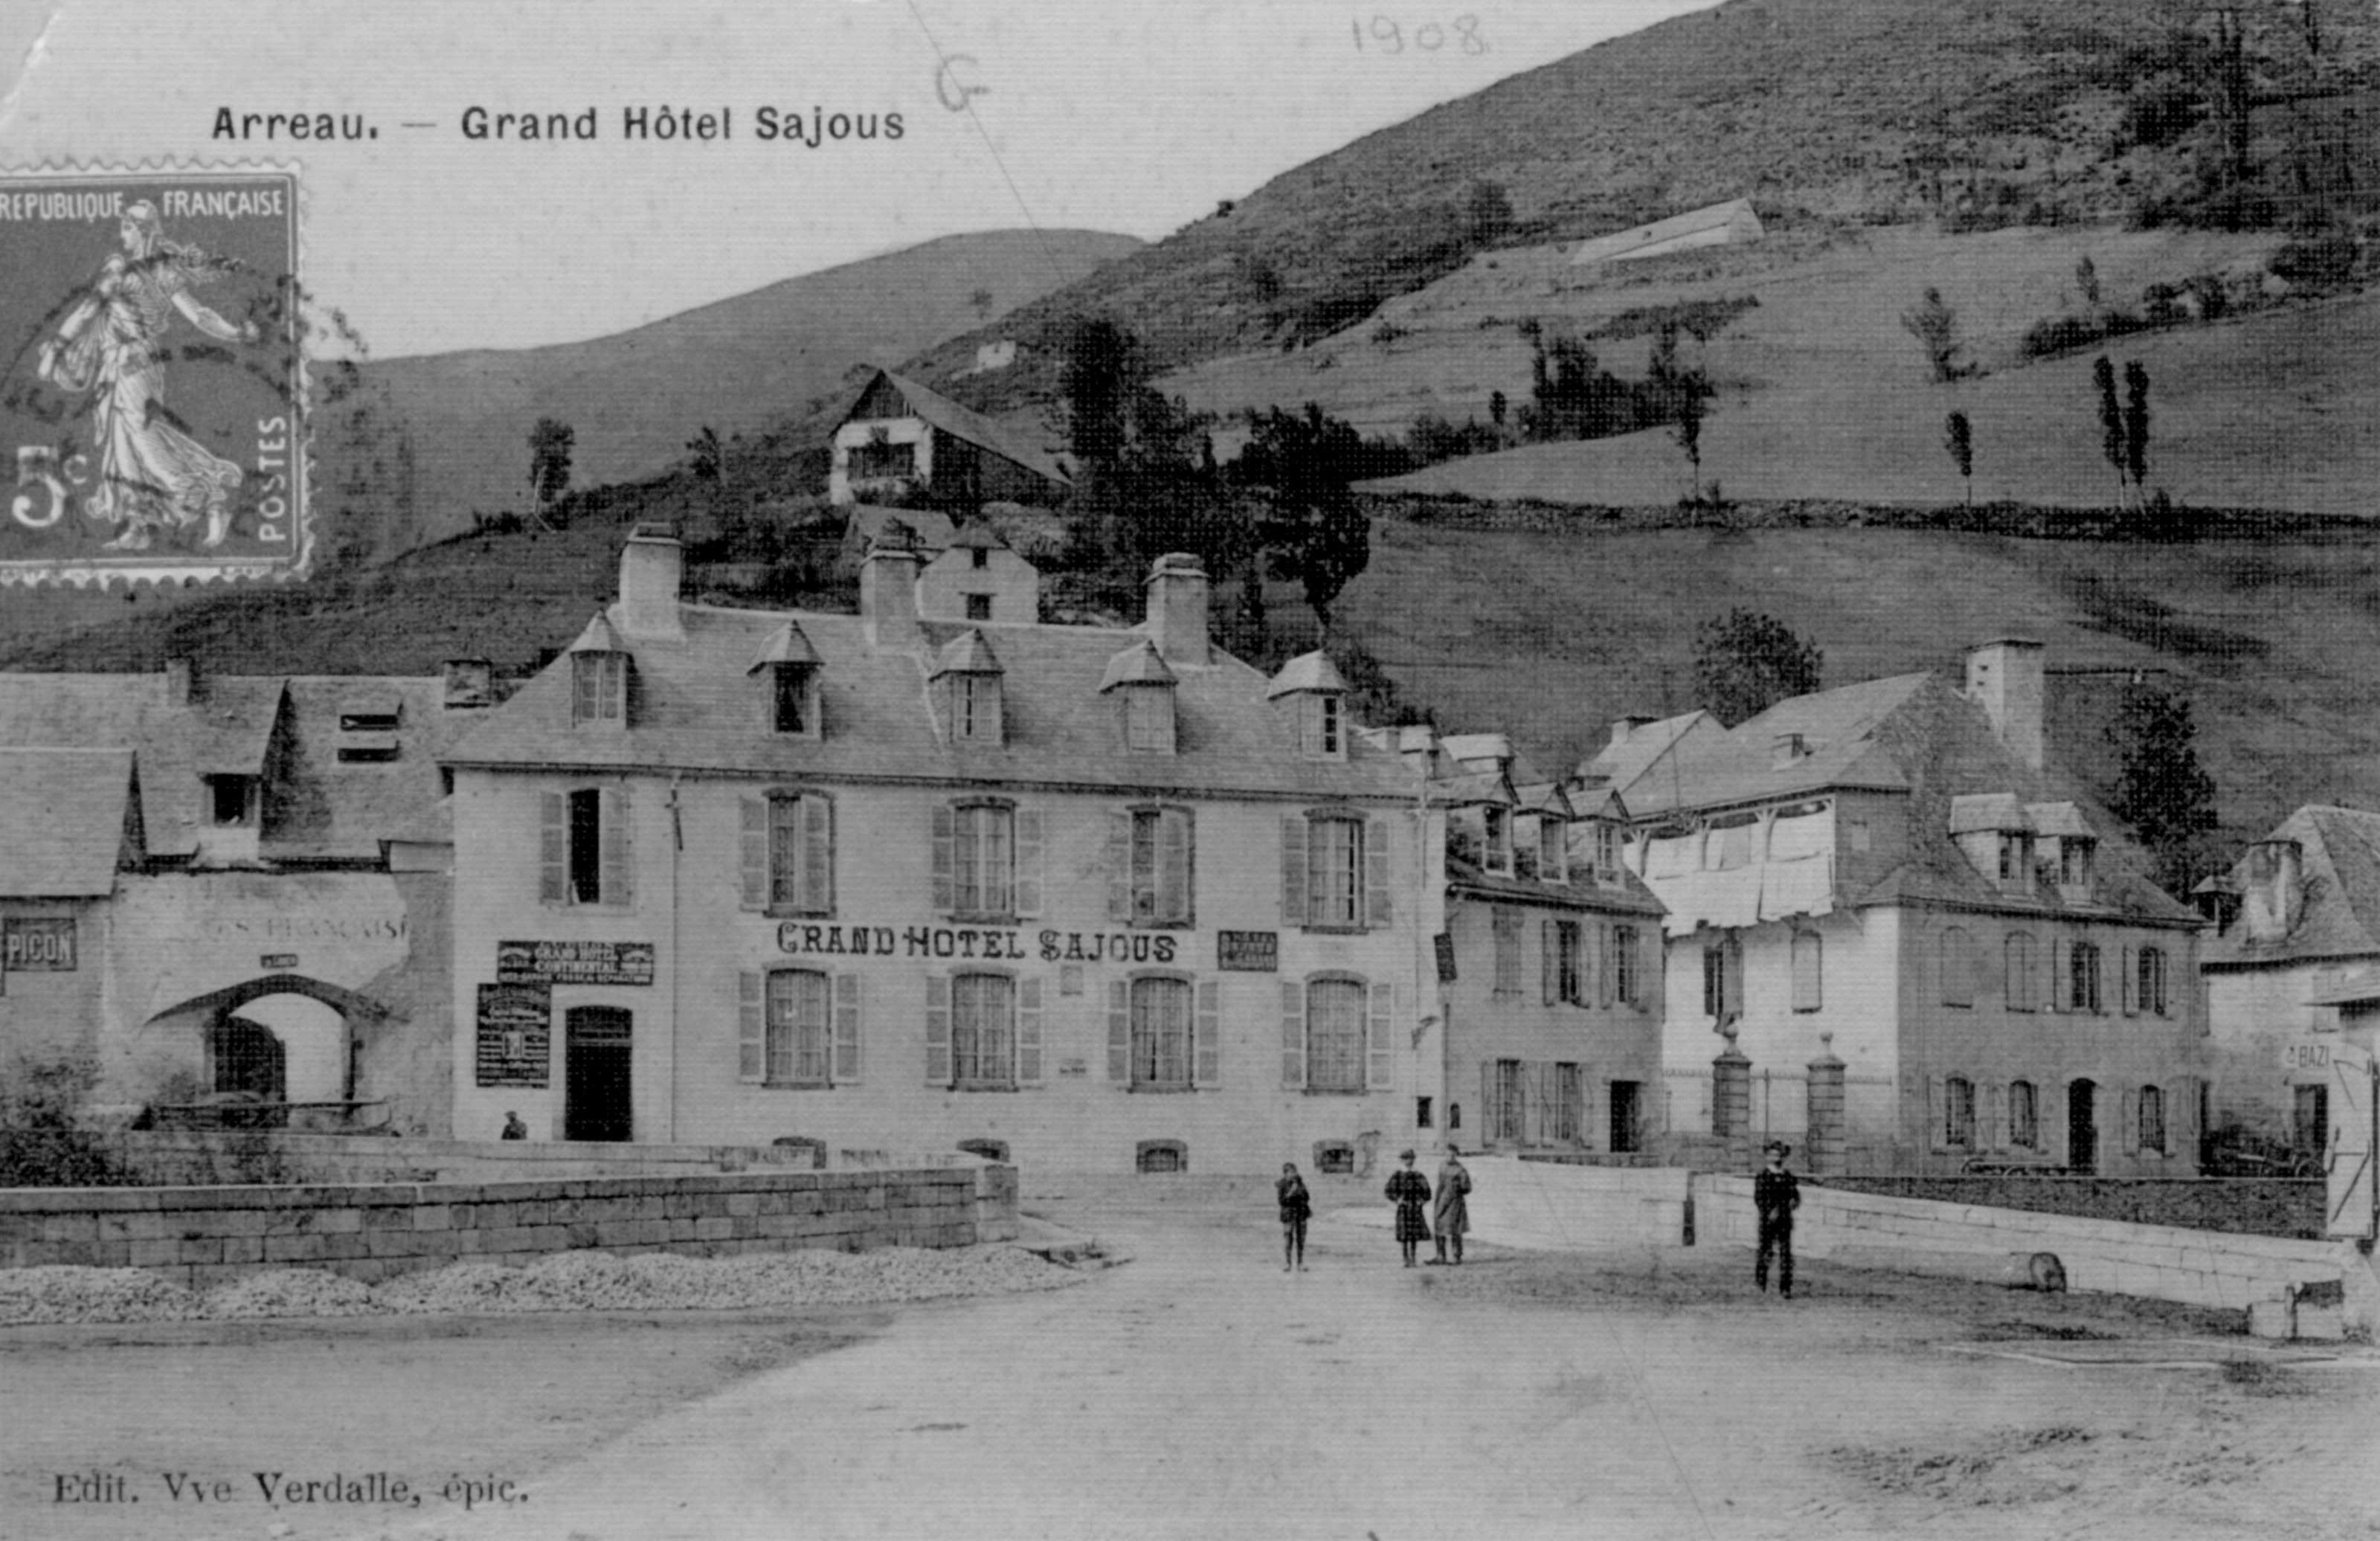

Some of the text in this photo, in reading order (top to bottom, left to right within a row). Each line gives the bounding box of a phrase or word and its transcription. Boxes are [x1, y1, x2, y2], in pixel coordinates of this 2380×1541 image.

[163, 190, 283, 221] FRANÇAISE
[257, 416, 287, 542] POSTES
[7, 933, 71, 962] PICON
[534, 947, 576, 960] GRAND
[578, 948, 619, 961] HOTEL
[776, 921, 1180, 963] GRAND HOTEL SAJOUS
[534, 959, 619, 973] CONTINENTAL
